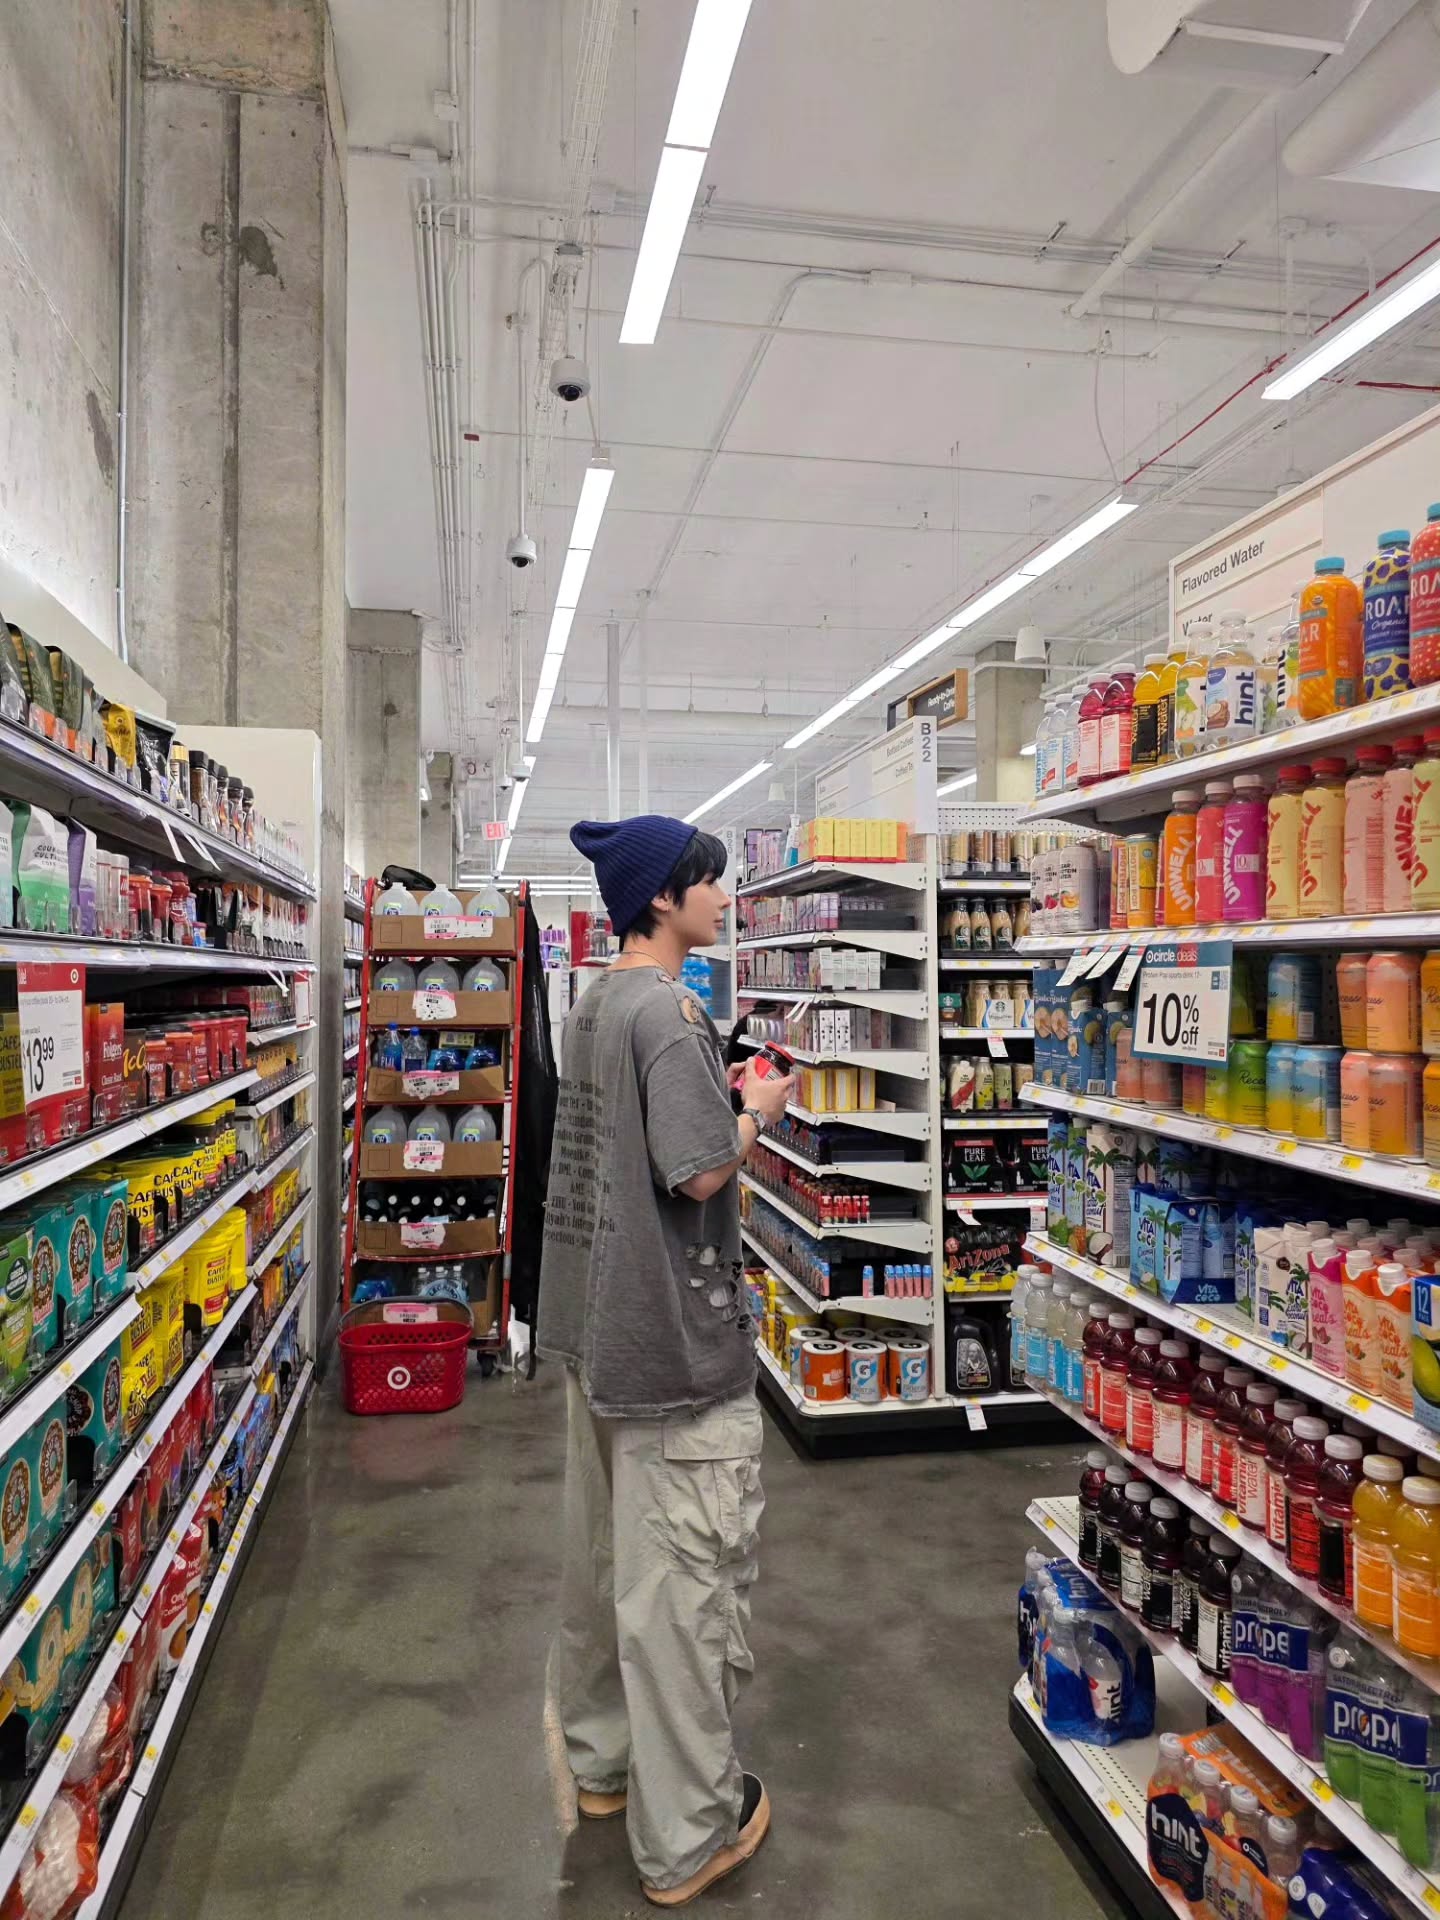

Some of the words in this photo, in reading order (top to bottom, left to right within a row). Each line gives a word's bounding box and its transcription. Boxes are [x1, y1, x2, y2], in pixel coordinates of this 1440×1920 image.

[1182, 557, 1227, 595] Flavored
[1230, 541, 1264, 568] Water
[1411, 573, 1440, 600] ROA
[1234, 671, 1255, 725] hint
[1181, 1026, 1199, 1046] off
[103, 1041, 122, 1062] Folgers
[964, 1147, 985, 1155] PURE
[964, 1154, 986, 1162] LEAF
[1031, 1153, 1049, 1161] LEA
[1197, 1283, 1218, 1294] VITA
[1416, 1285, 1429, 1314] 12
[1247, 1460, 1258, 1499] water
[1235, 1619, 1289, 1657] prope
[1151, 1803, 1203, 1859] hint
